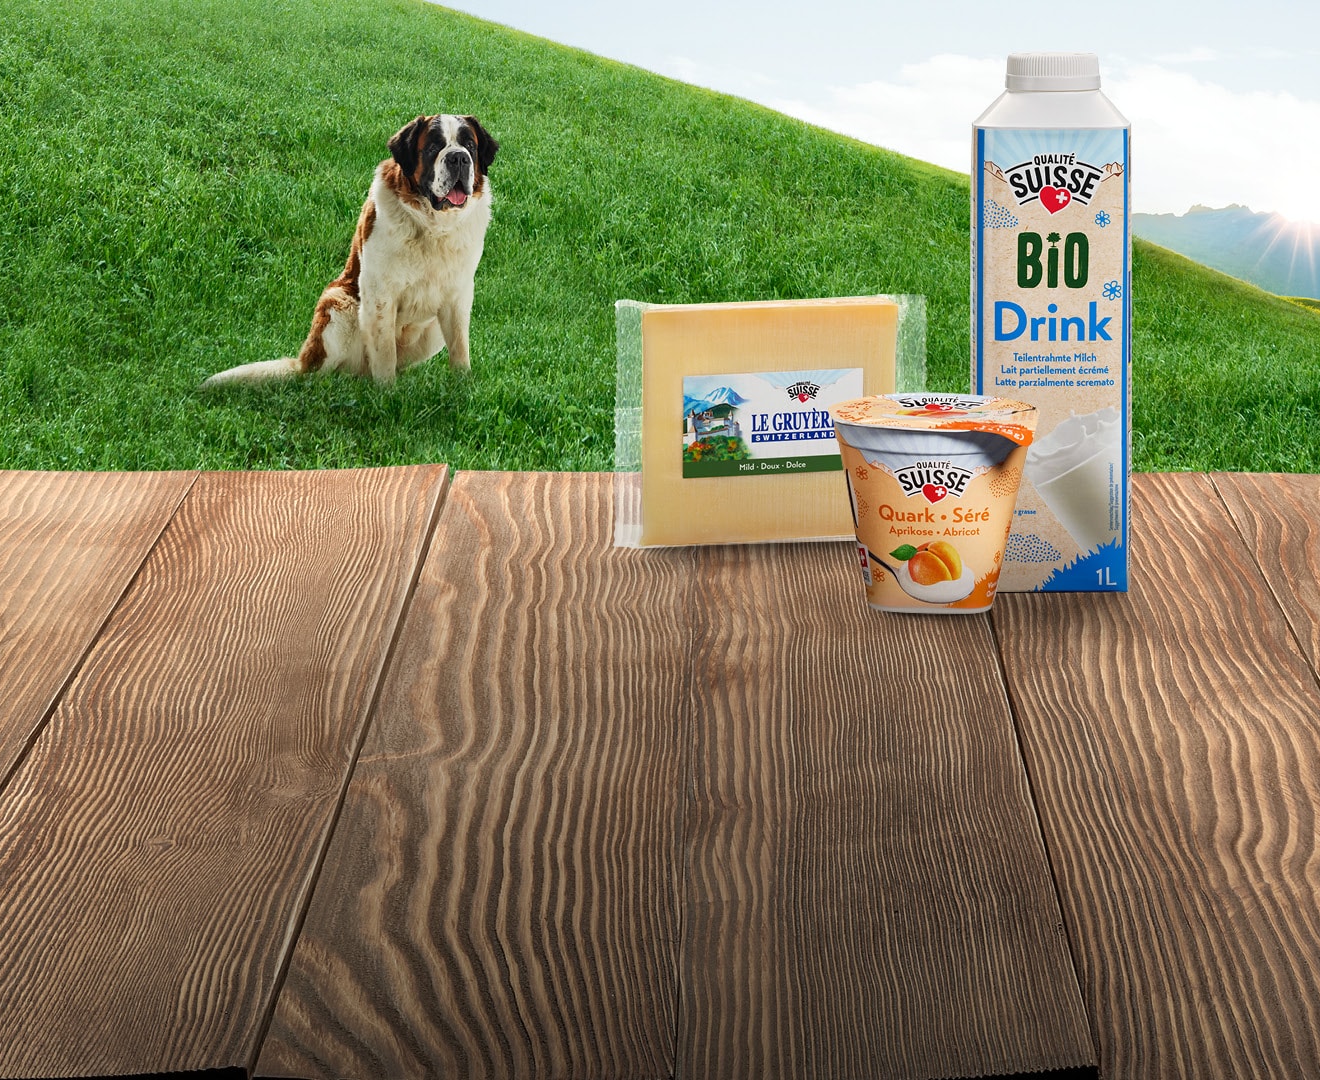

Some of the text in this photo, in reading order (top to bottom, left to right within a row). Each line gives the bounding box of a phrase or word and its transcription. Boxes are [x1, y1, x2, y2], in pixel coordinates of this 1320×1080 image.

[1034, 153, 1075, 165] QUALITÉ
[1009, 166, 1101, 199] SUISSE
[994, 301, 1113, 341] Drink
[1013, 352, 1097, 362] Teilentrahmte Milch
[1001, 365, 1109, 376] Lait partiellement écrémé
[995, 377, 1114, 388] Latte parzialmente scremato
[787, 386, 819, 398] SUISSE
[751, 408, 835, 432] LE GRUYÈR
[755, 432, 835, 441] SWITZERLAND
[739, 461, 807, 471] Mild Doux Dolce
[916, 460, 952, 469] QUALITÉ
[898, 469, 971, 493] SUISSE
[879, 504, 990, 523] Quark Séré
[889, 525, 980, 537] Aprikose Abricot
[1095, 567, 1117, 586] 1L
